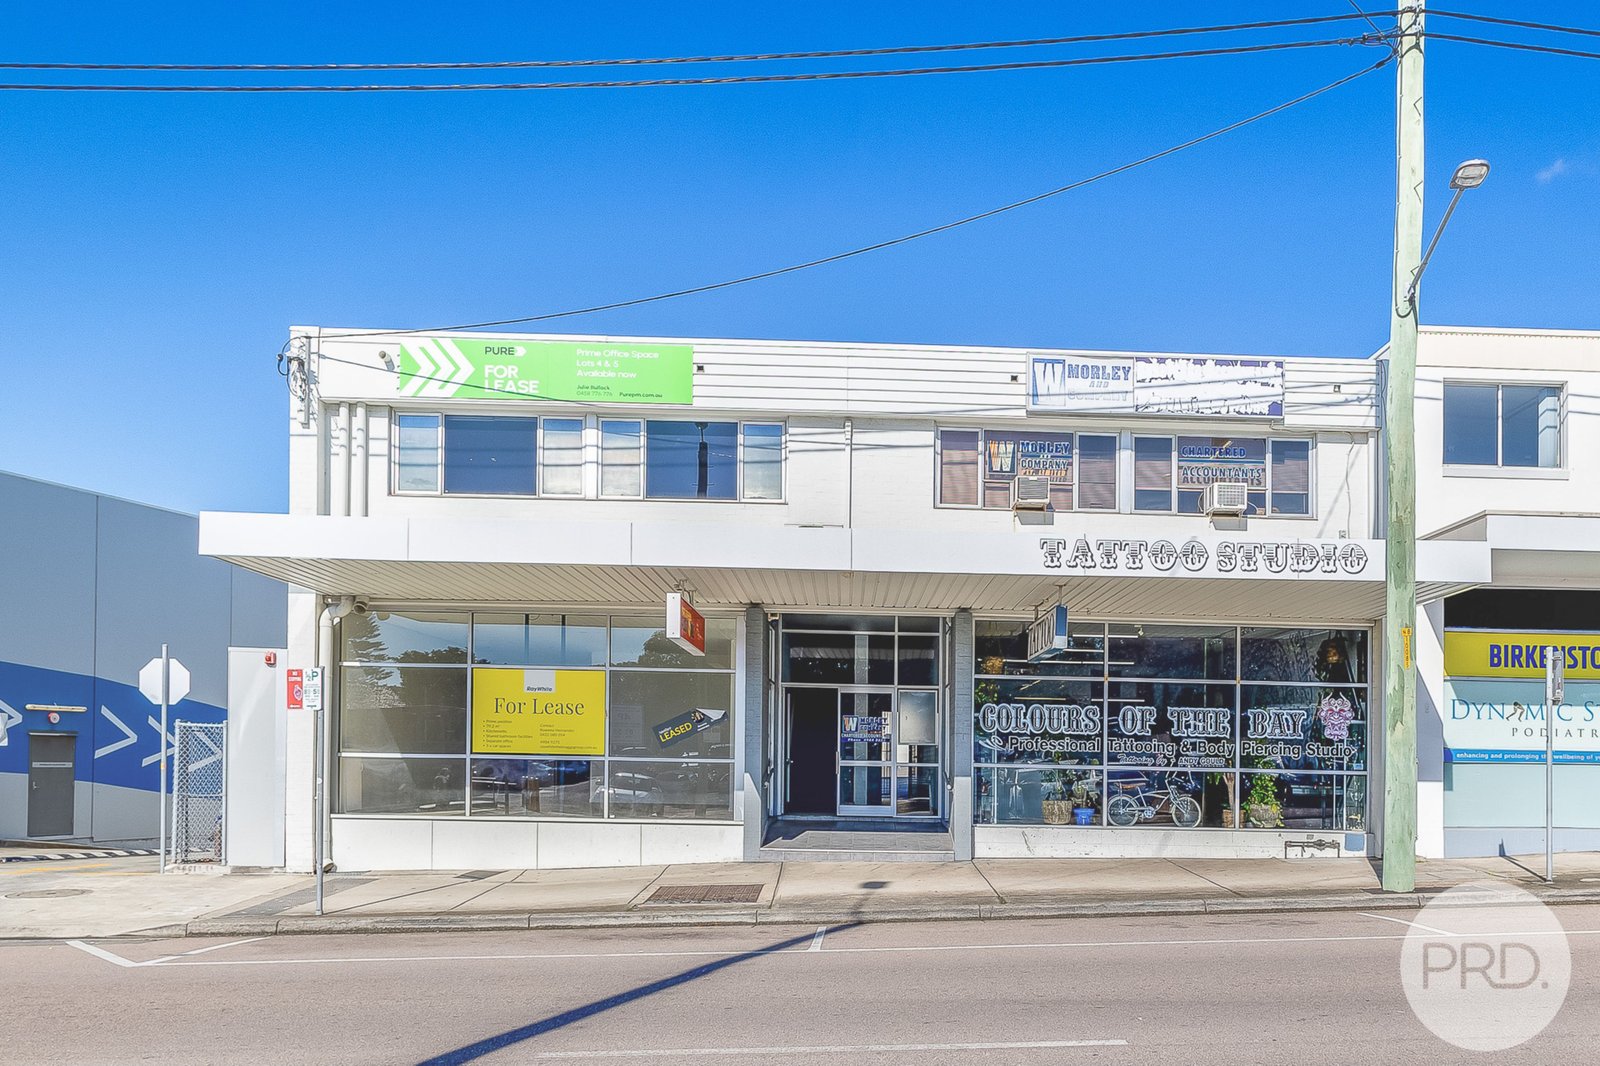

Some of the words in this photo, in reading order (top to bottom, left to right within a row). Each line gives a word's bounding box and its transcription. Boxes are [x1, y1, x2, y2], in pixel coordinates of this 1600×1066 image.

[484, 346, 515, 356] PURE
[576, 348, 602, 357] Prime
[603, 348, 630, 358] Office
[631, 350, 660, 359] Space
[484, 364, 519, 379] FOR
[576, 369, 617, 378] Available
[617, 371, 638, 379] now
[1067, 363, 1132, 381] MORLEY
[484, 379, 540, 394] LEASE
[1088, 380, 1110, 389] AND
[1019, 440, 1071, 454] MORLEY
[1181, 445, 1246, 459] CHARTERED
[1020, 458, 1069, 470] COMPANY
[1181, 467, 1263, 479] ACCOUNTANTS
[1039, 537, 1209, 571] TATTOO
[1216, 540, 1369, 575] STUDIO
[494, 697, 527, 714] For
[532, 698, 585, 716] Lease
[1583, 700, 1600, 722] S
[979, 703, 1102, 736] COLOURS
[1118, 705, 1157, 736] OF
[1166, 706, 1231, 739] THE
[1247, 708, 1307, 740] BAY
[659, 722, 693, 743] LEASED
[1008, 735, 1102, 754] Professional
[1106, 737, 1176, 760] Tattooing
[1179, 738, 1194, 756] &
[1196, 739, 1236, 761] Body
[1241, 740, 1302, 761] Piercing
[1305, 741, 1353, 759] Studio
[1177, 756, 1199, 765] ANDY
[1199, 756, 1226, 765] GOULD
[1456, 752, 1489, 760] enhancing
[1503, 753, 1539, 761] prolonging
[1553, 753, 1585, 761] wellbeing
